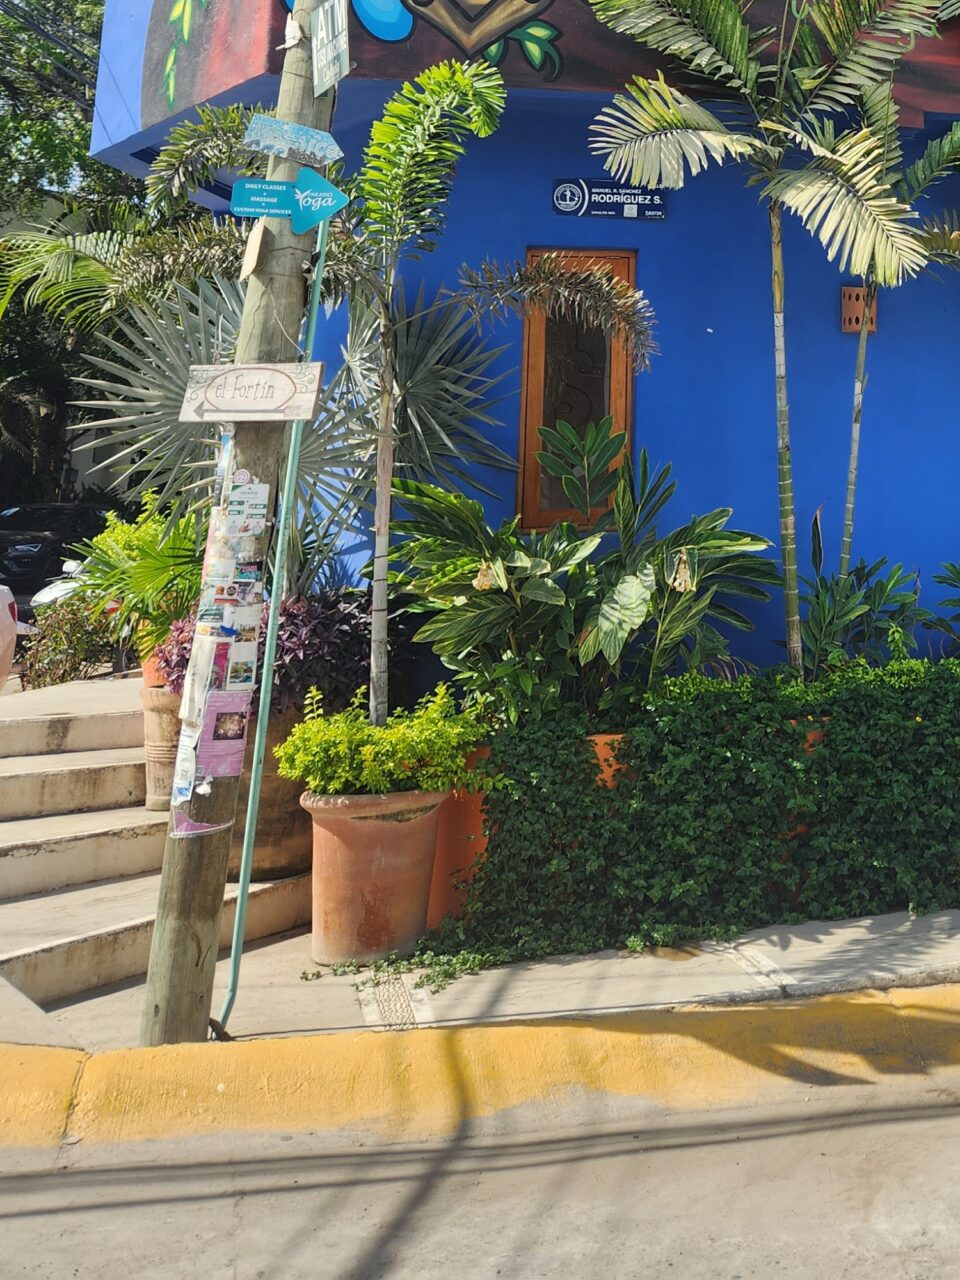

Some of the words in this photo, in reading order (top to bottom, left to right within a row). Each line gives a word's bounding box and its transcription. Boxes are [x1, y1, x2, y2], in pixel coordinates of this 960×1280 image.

[295, 188, 337, 211] Yoga
[591, 193, 651, 204] RODRÍGUEZ
[653, 195, 663, 204] S.
[215, 376, 228, 399] el
[231, 373, 275, 401] Fortín
